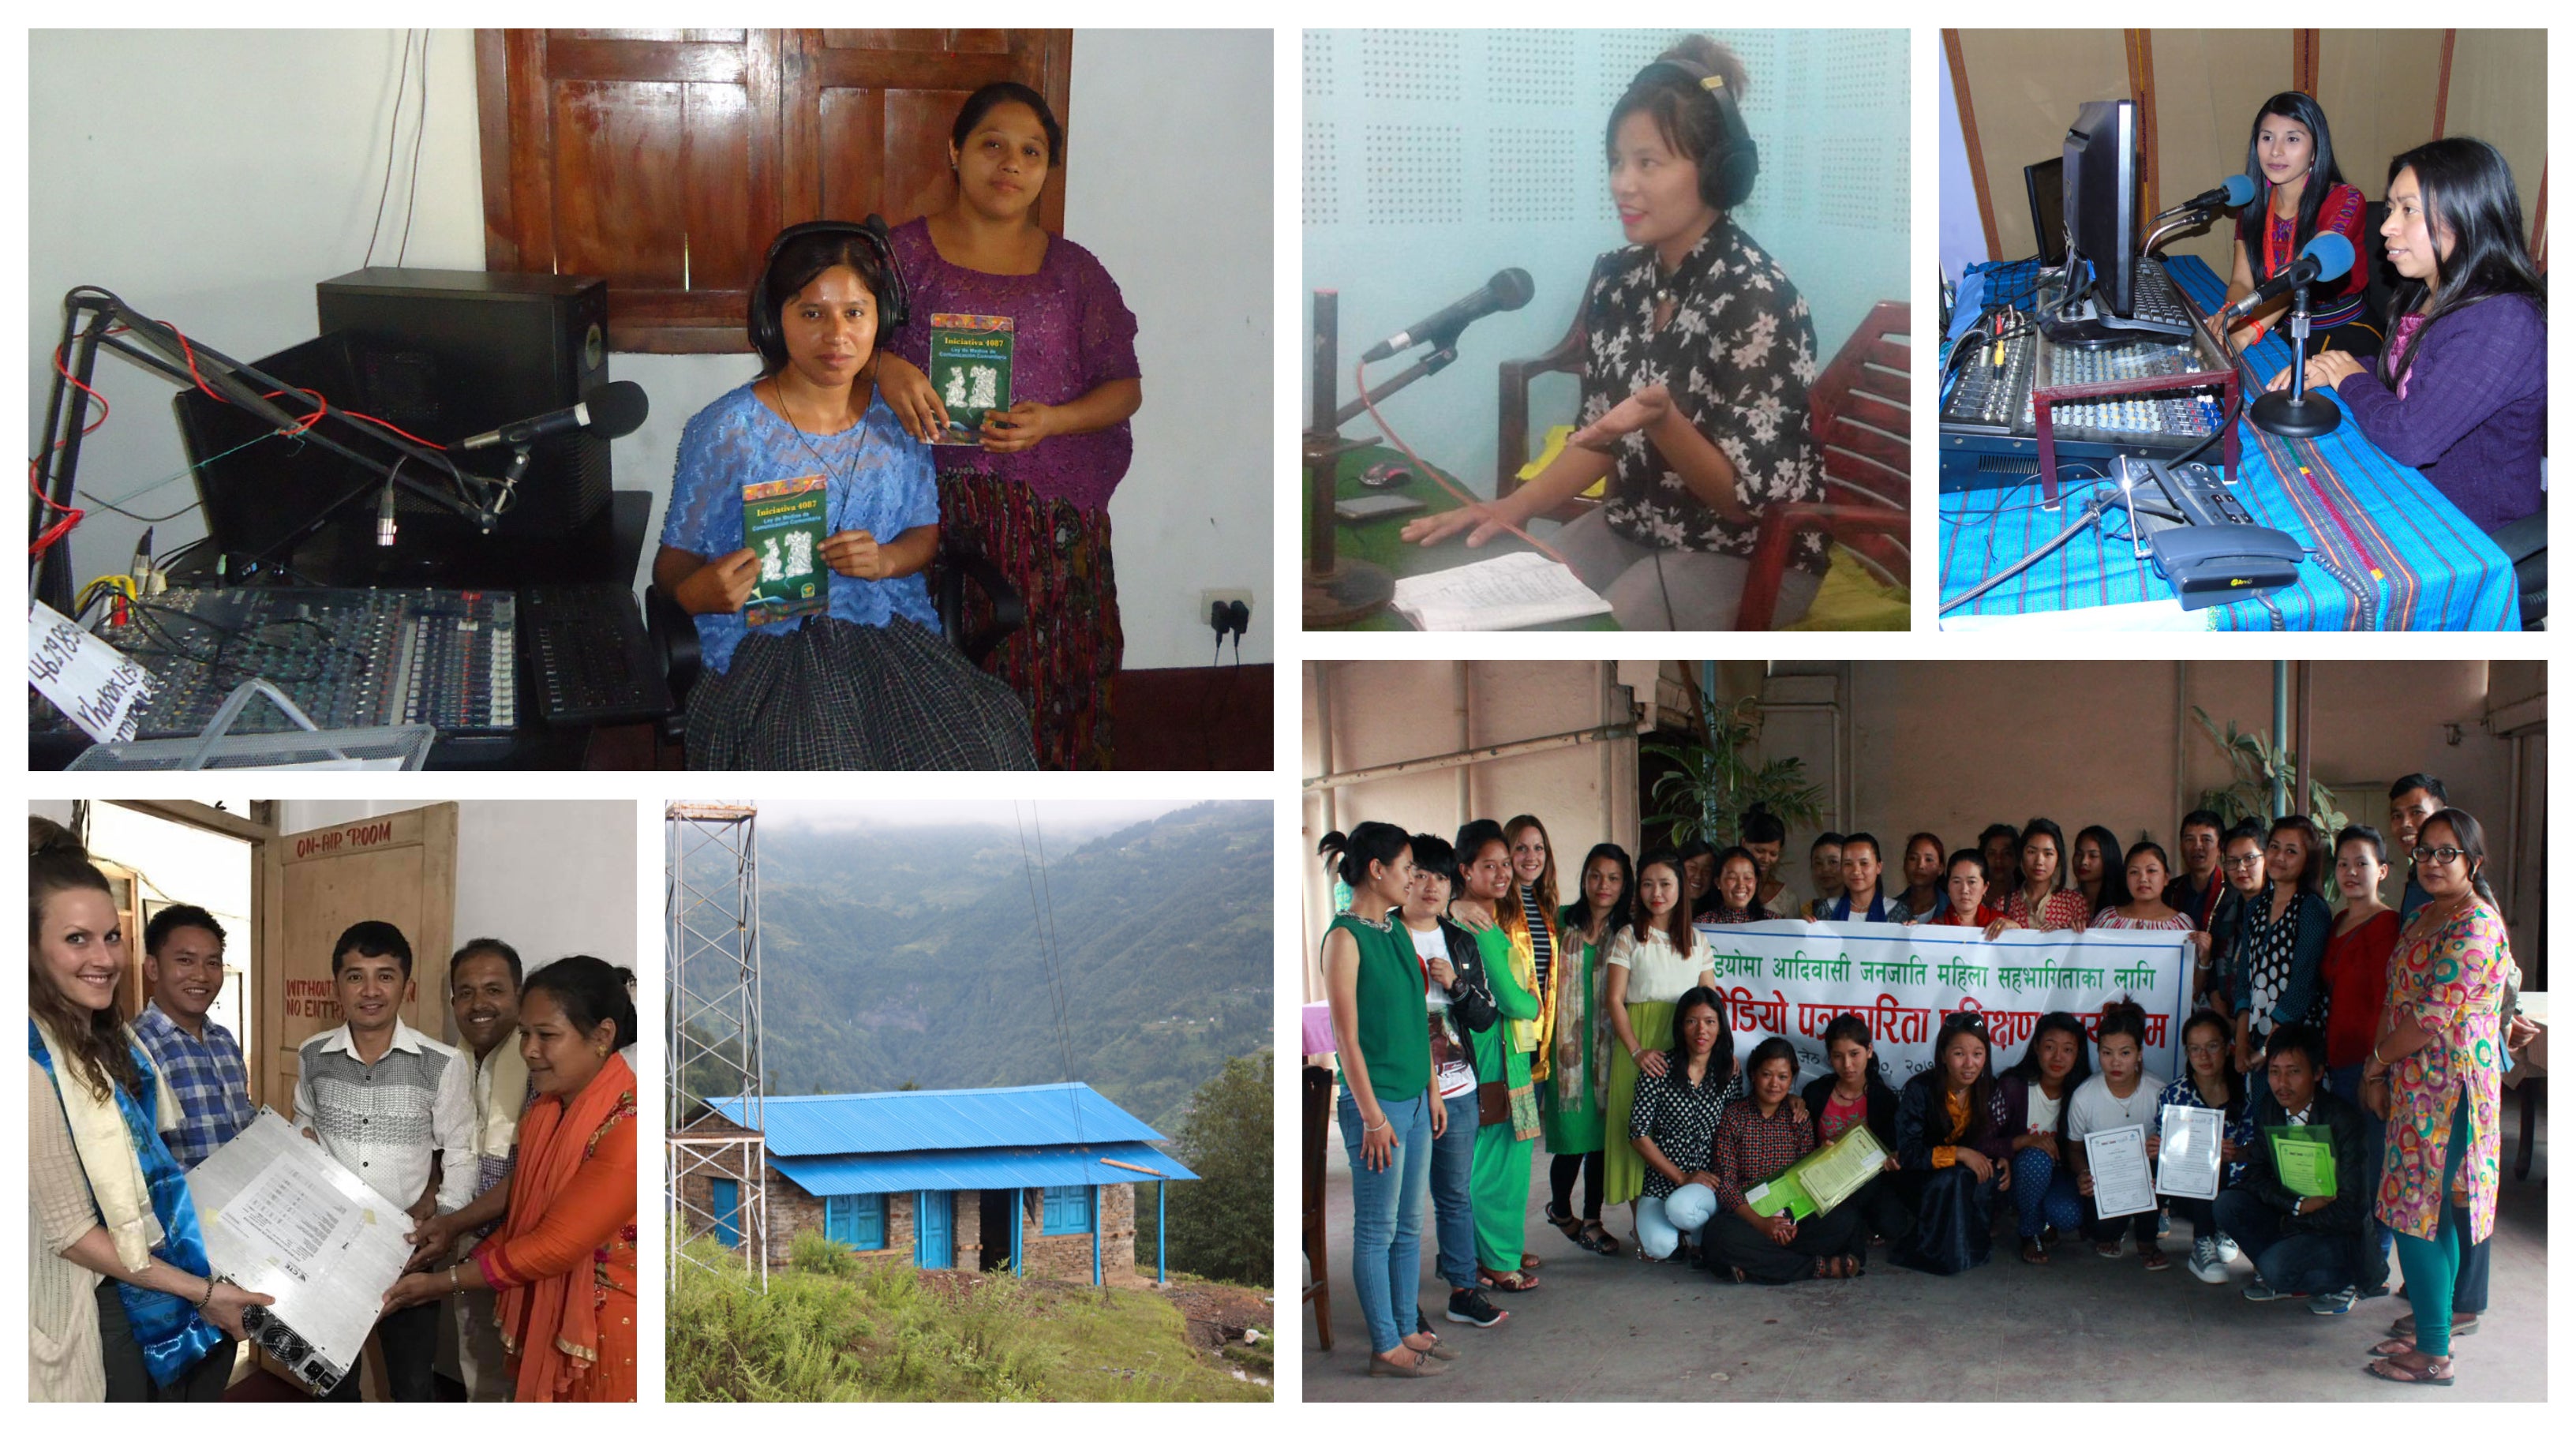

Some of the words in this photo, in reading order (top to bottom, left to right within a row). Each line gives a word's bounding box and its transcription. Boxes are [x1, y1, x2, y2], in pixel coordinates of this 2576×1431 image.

[945, 337, 983, 346] Iniciativa
[757, 505, 796, 516] Iniciativa
[798, 500, 817, 510] 4087
[297, 831, 343, 858] ON-AIR
[346, 821, 391, 846] ROOM
[1773, 950, 1852, 983] आदिवासी
[1860, 954, 1928, 986] जनजाति
[1937, 956, 1989, 992] महिला
[1998, 958, 2105, 995] सहभागिताका
[2114, 960, 2156, 991] लागि
[286, 980, 331, 997] WITHOUT
[286, 999, 301, 1017] NO
